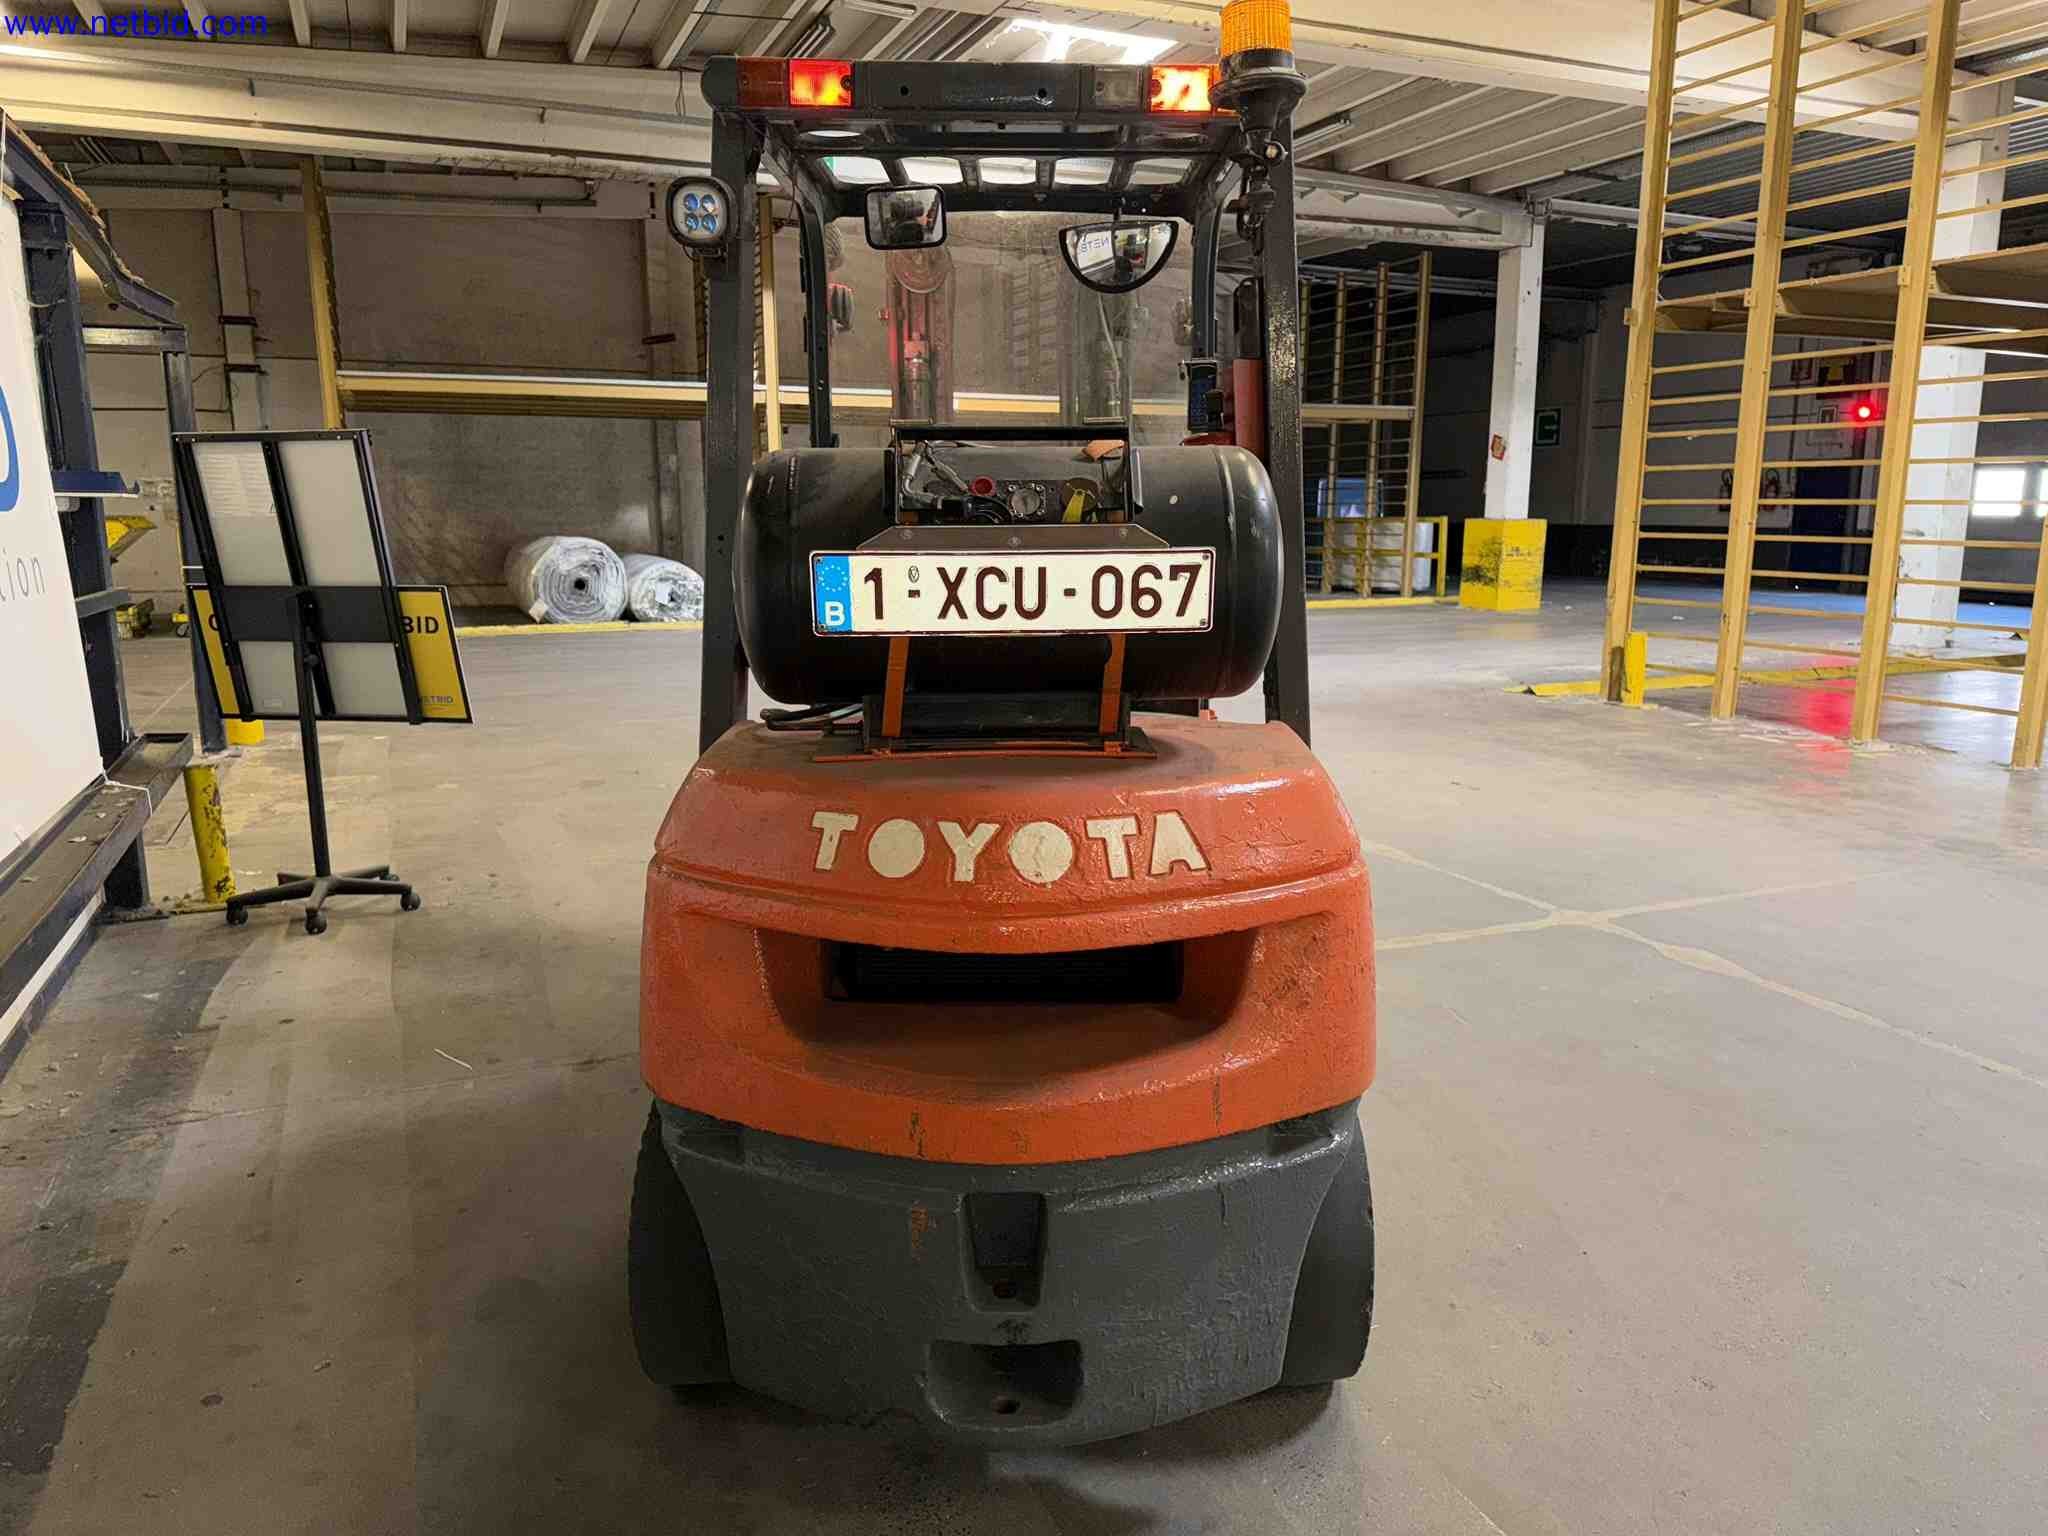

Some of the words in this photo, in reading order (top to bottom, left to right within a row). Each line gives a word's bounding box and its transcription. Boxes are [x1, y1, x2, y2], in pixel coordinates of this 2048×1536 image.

[0, 546, 45, 602] ion
[824, 600, 846, 627] B
[811, 810, 1212, 884] TOYOTA
